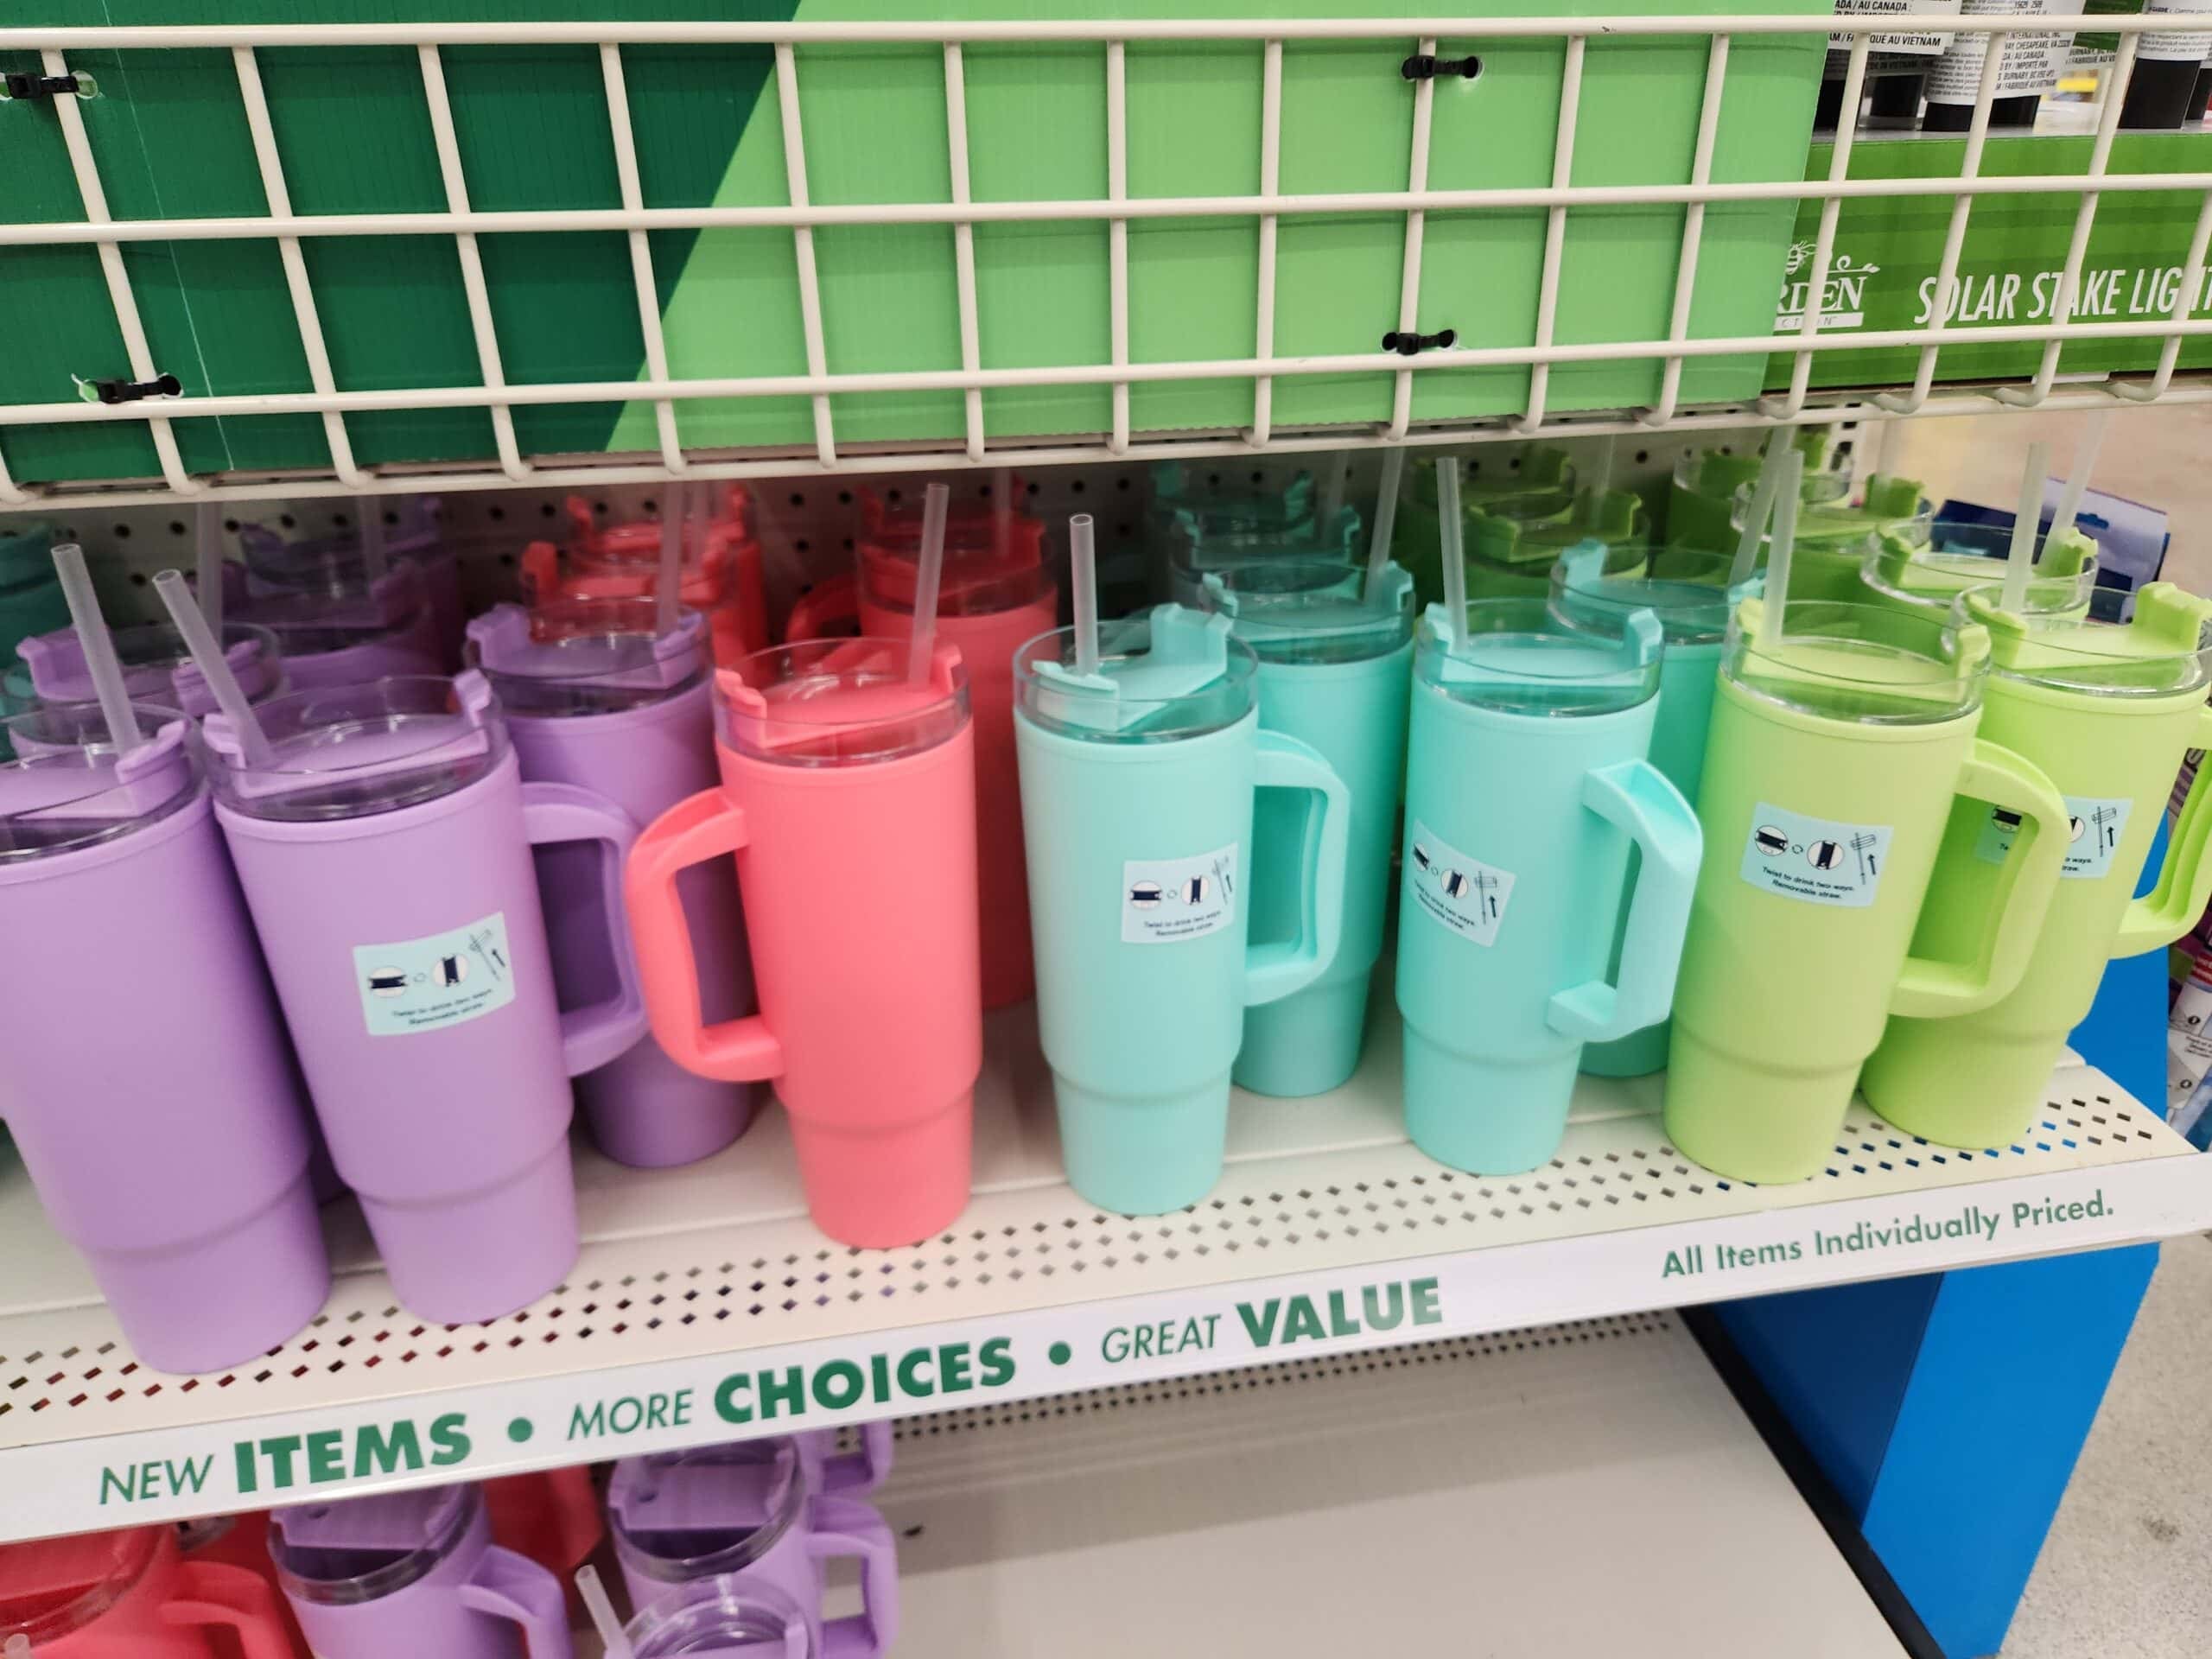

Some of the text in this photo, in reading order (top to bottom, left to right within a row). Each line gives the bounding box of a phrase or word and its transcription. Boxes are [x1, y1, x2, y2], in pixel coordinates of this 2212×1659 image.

[1859, 1, 1871, 10] AU
[1872, 1, 1907, 11] CANADA
[1887, 35, 1900, 45] AU
[1902, 35, 1942, 47] VIETNAM
[1763, 866, 1782, 878] Twist
[1794, 877, 1815, 887] drink
[1772, 879, 1816, 895] Removable
[1662, 1188, 2115, 1278] All Items Individually Priced.
[99, 1276, 1444, 1506] NEW ITEMS MORE CHOICES GREAT VALUE
